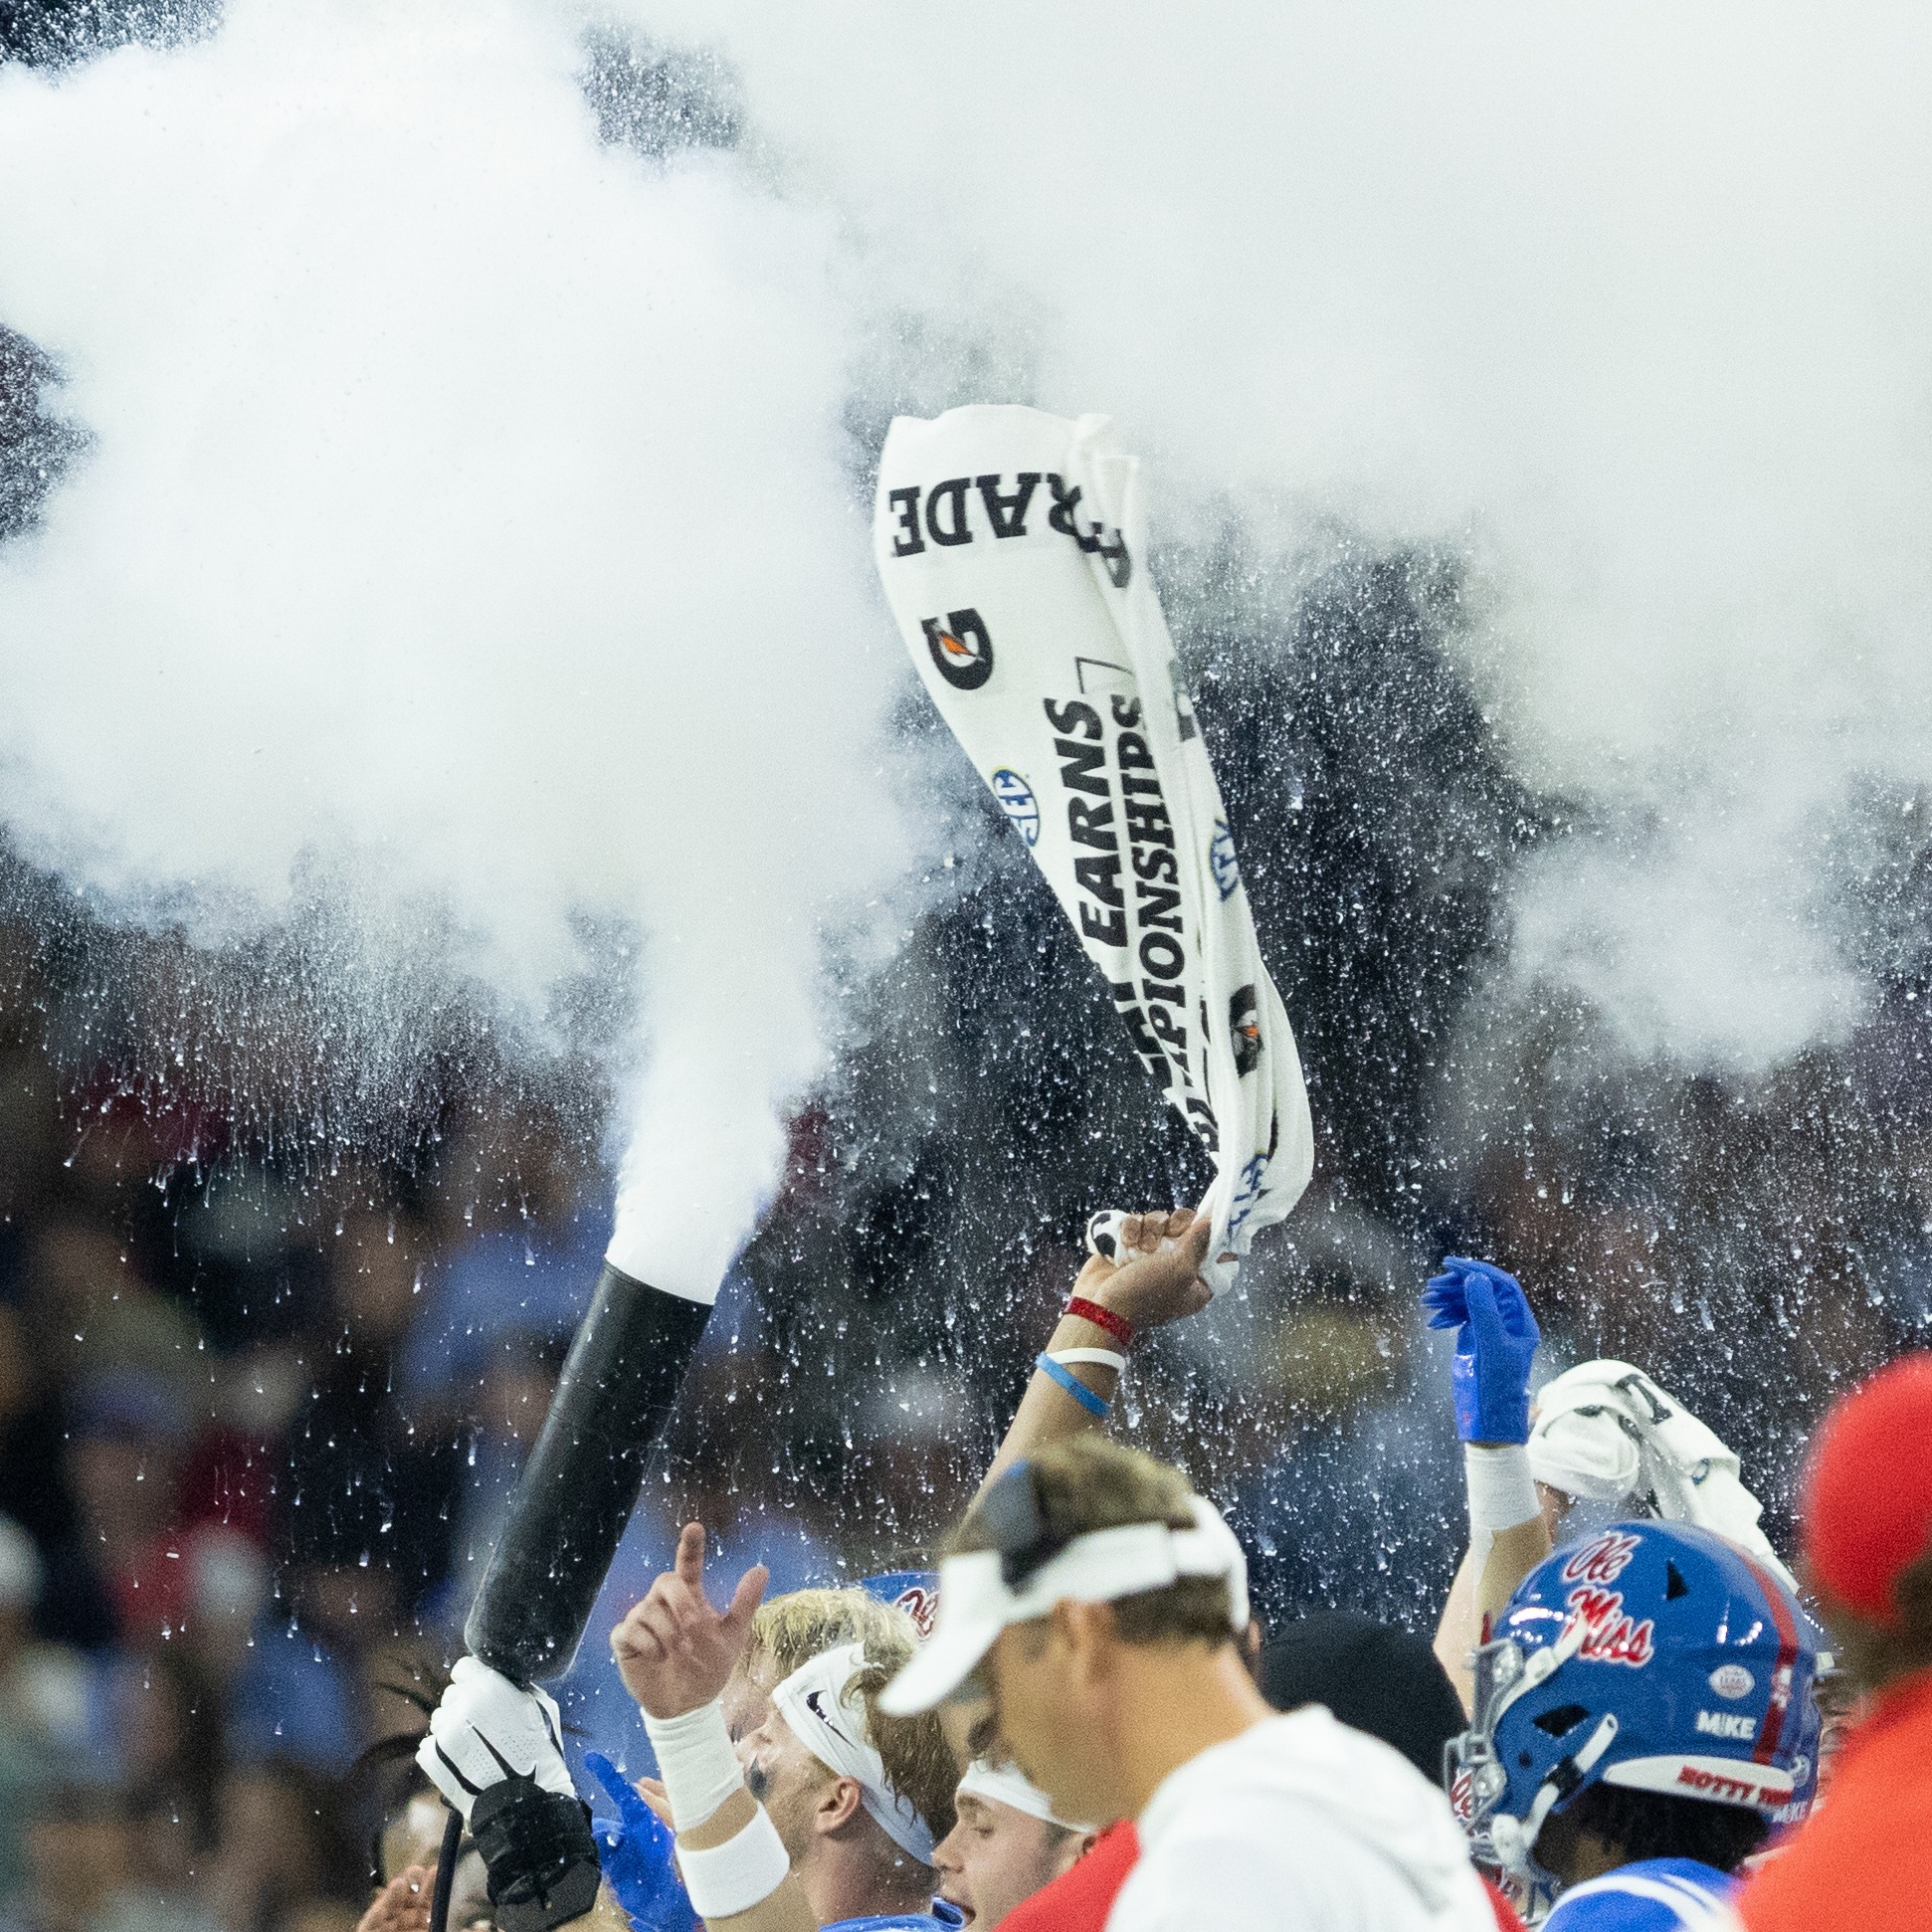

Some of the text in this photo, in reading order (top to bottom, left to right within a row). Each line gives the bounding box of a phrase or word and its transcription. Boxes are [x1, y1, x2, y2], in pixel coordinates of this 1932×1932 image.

[920, 608, 994, 690] G
[1044, 697, 1129, 948] EARNS
[1110, 693, 1195, 1090] PIONSHIPS
[1563, 1531, 1642, 1585] Ole
[1562, 1586, 1655, 1667] Miss
[1696, 1710, 1757, 1741] MIKE
